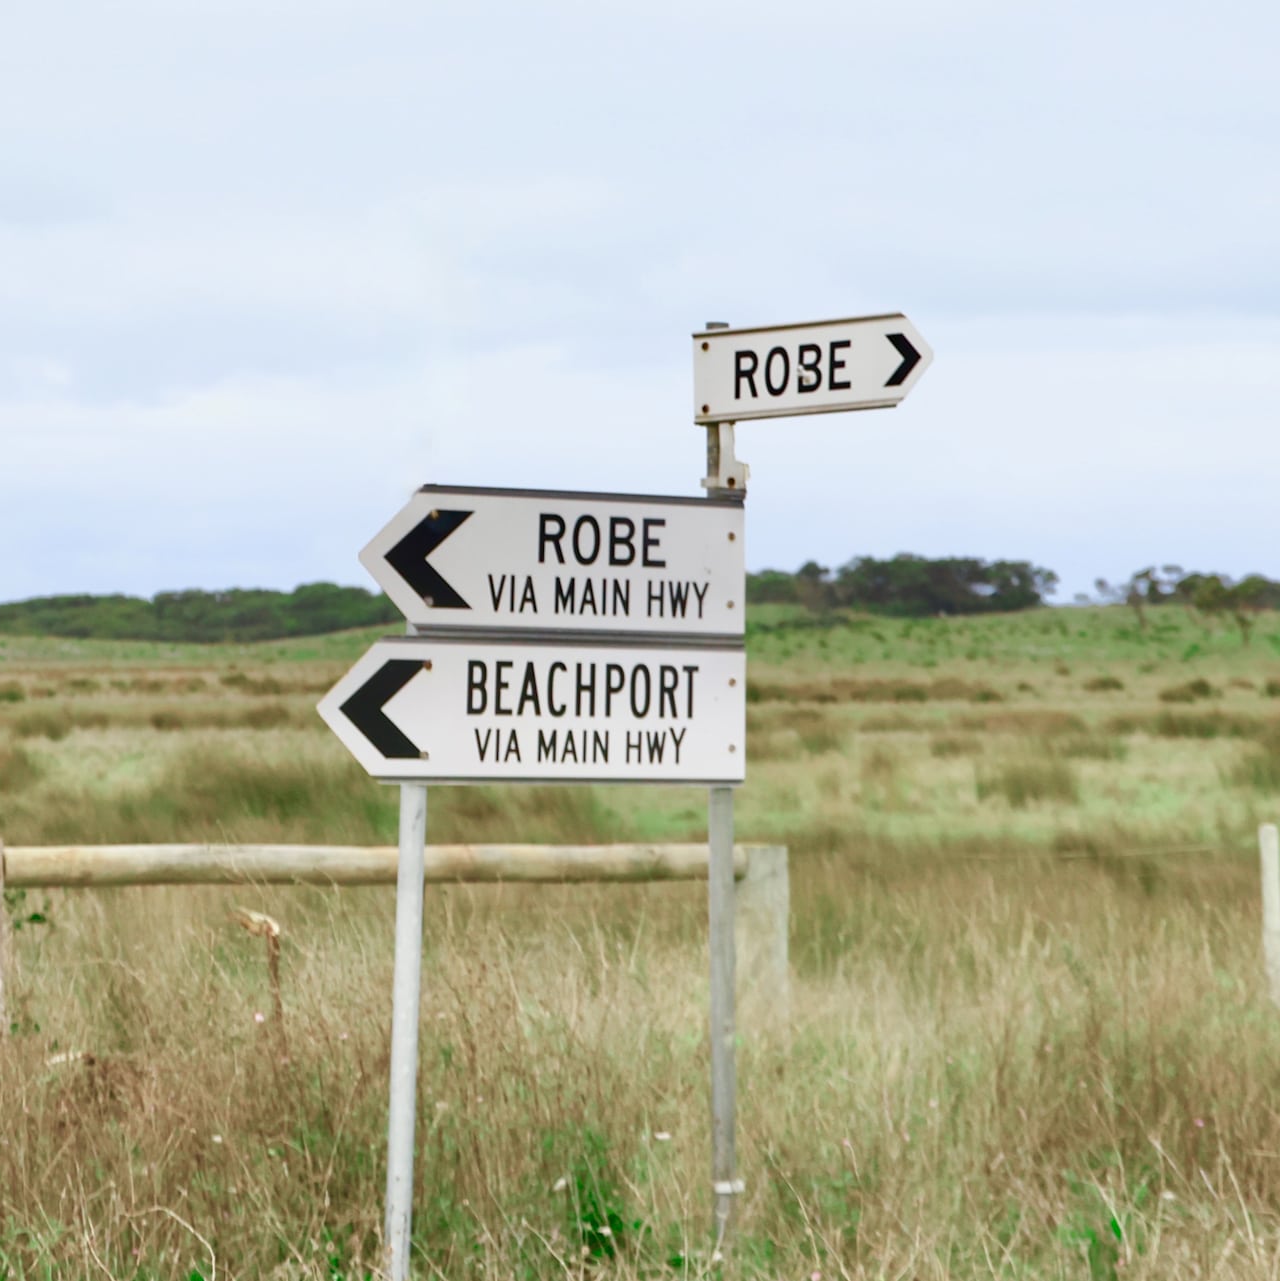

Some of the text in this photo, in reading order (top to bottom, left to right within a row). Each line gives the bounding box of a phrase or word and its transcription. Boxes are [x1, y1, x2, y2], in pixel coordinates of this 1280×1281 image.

[734, 339, 852, 400] ROBE
[538, 512, 667, 569] ROBE
[487, 573, 709, 619] VIA MAIN HWY
[466, 659, 699, 719] BEACHPORT
[474, 727, 686, 764] VIA MAIN HWY
